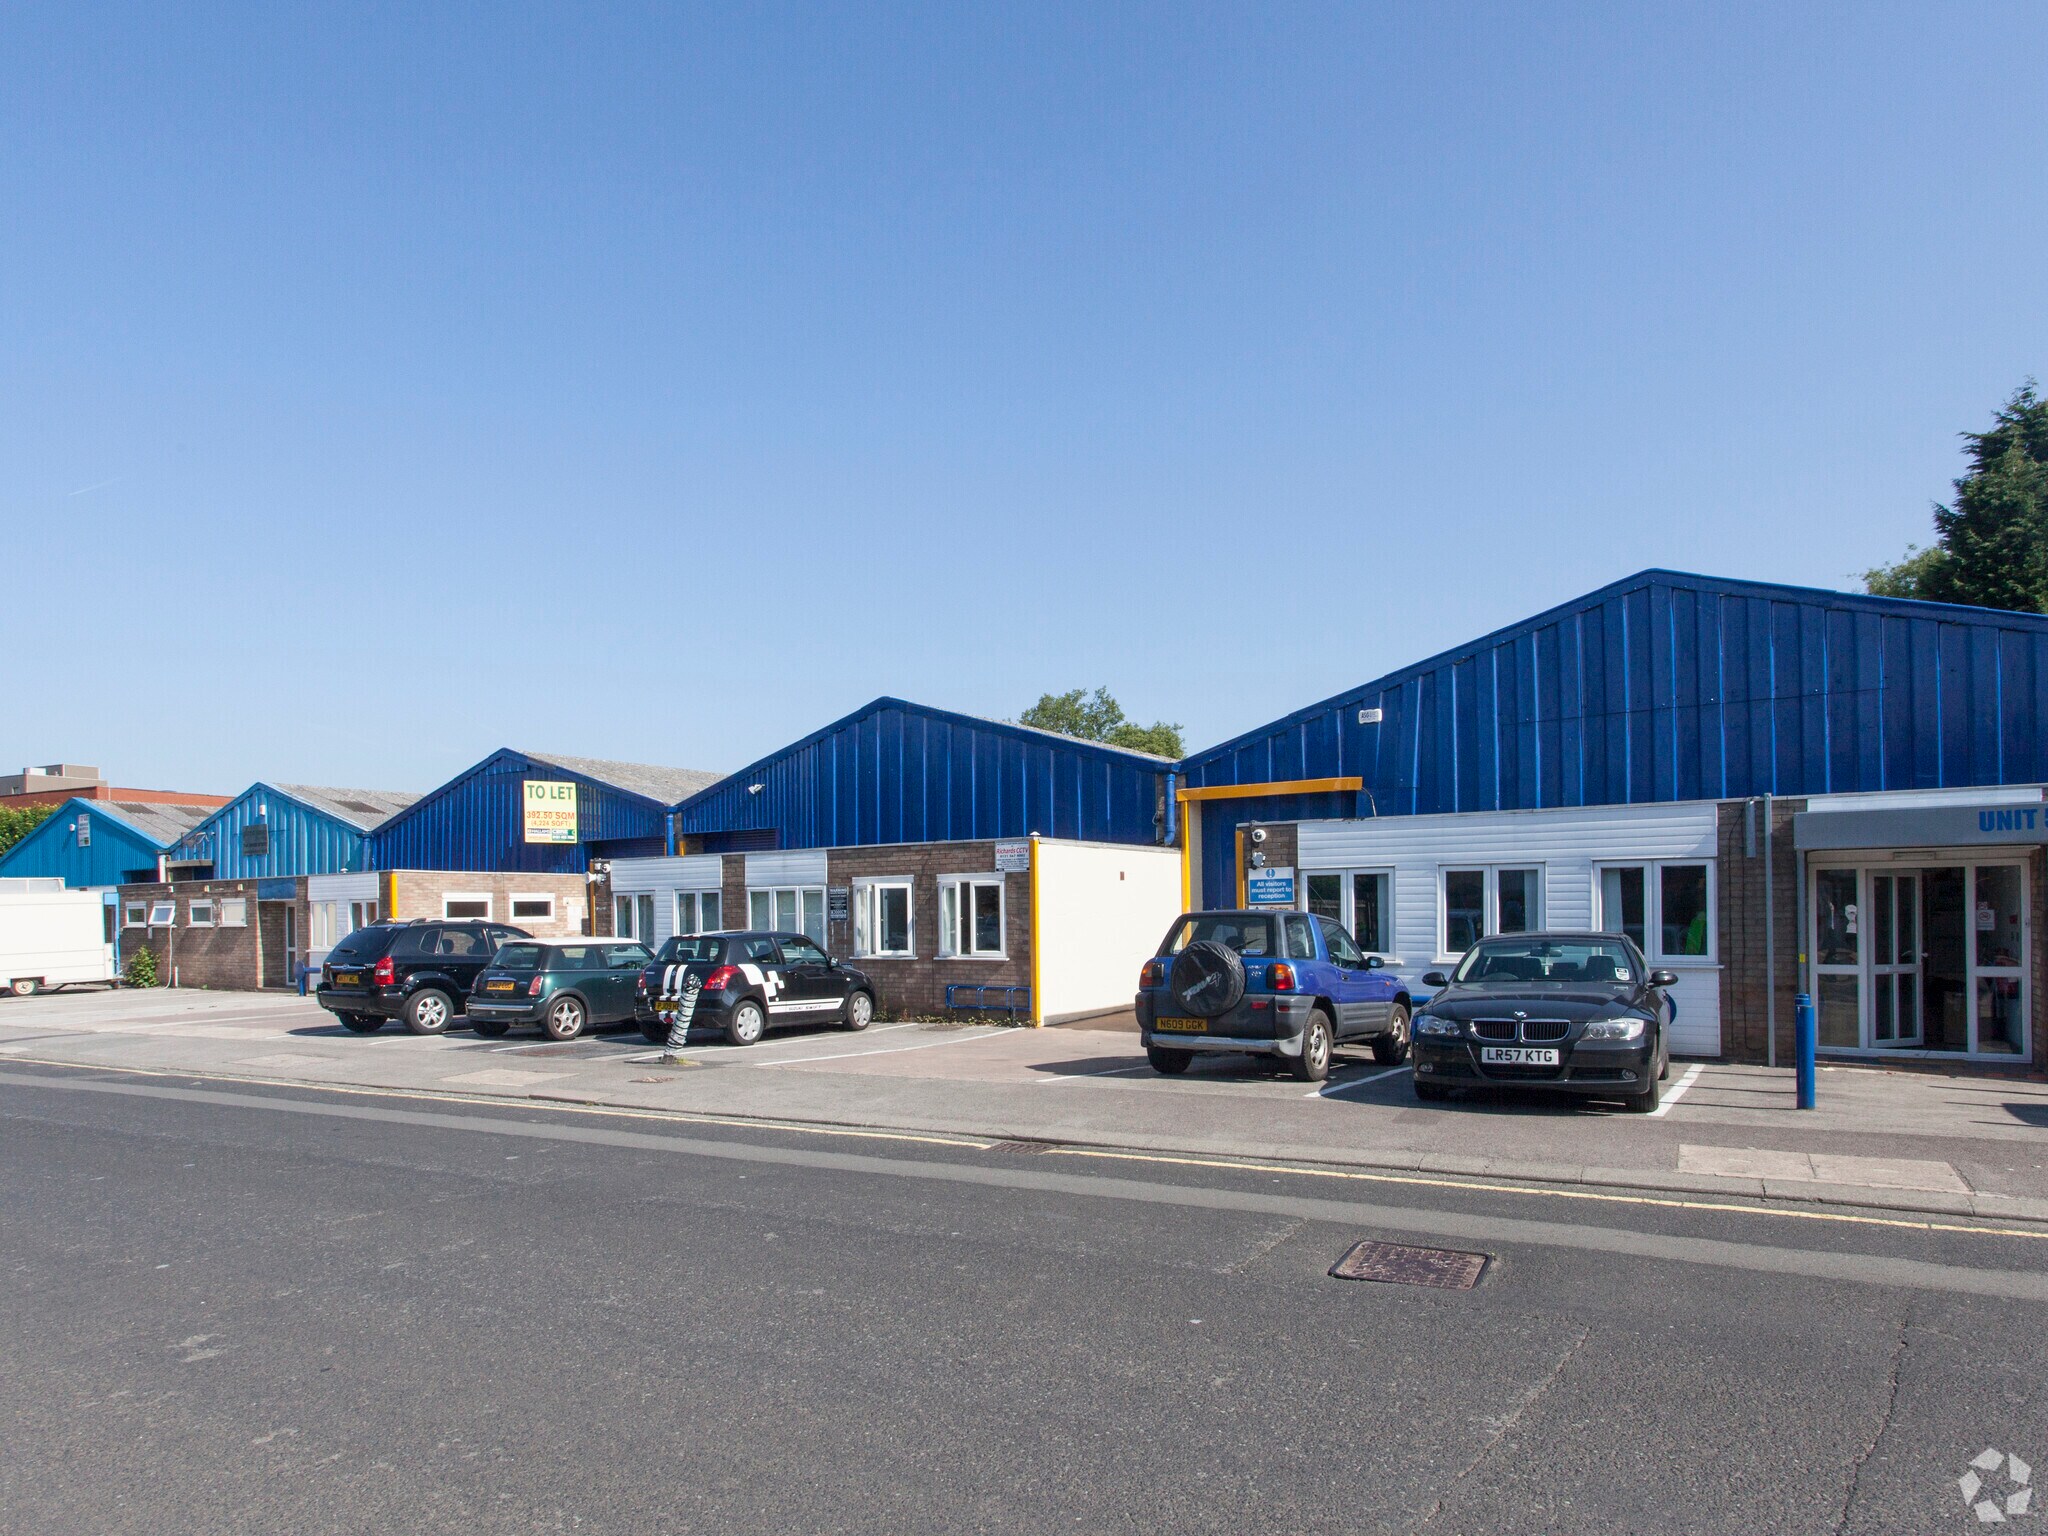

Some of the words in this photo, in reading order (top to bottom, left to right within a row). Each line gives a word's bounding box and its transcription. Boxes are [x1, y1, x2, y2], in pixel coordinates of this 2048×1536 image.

[527, 785, 545, 799] TO
[550, 786, 573, 800] LET
[527, 811, 552, 819] 392.50
[555, 812, 575, 820] SQM
[1979, 808, 2038, 832] UNIT
[1160, 1020, 1183, 1029] N609
[1186, 1021, 1204, 1029] GGK
[1487, 1049, 1521, 1061] LR57
[1525, 1050, 1552, 1062] KTG
